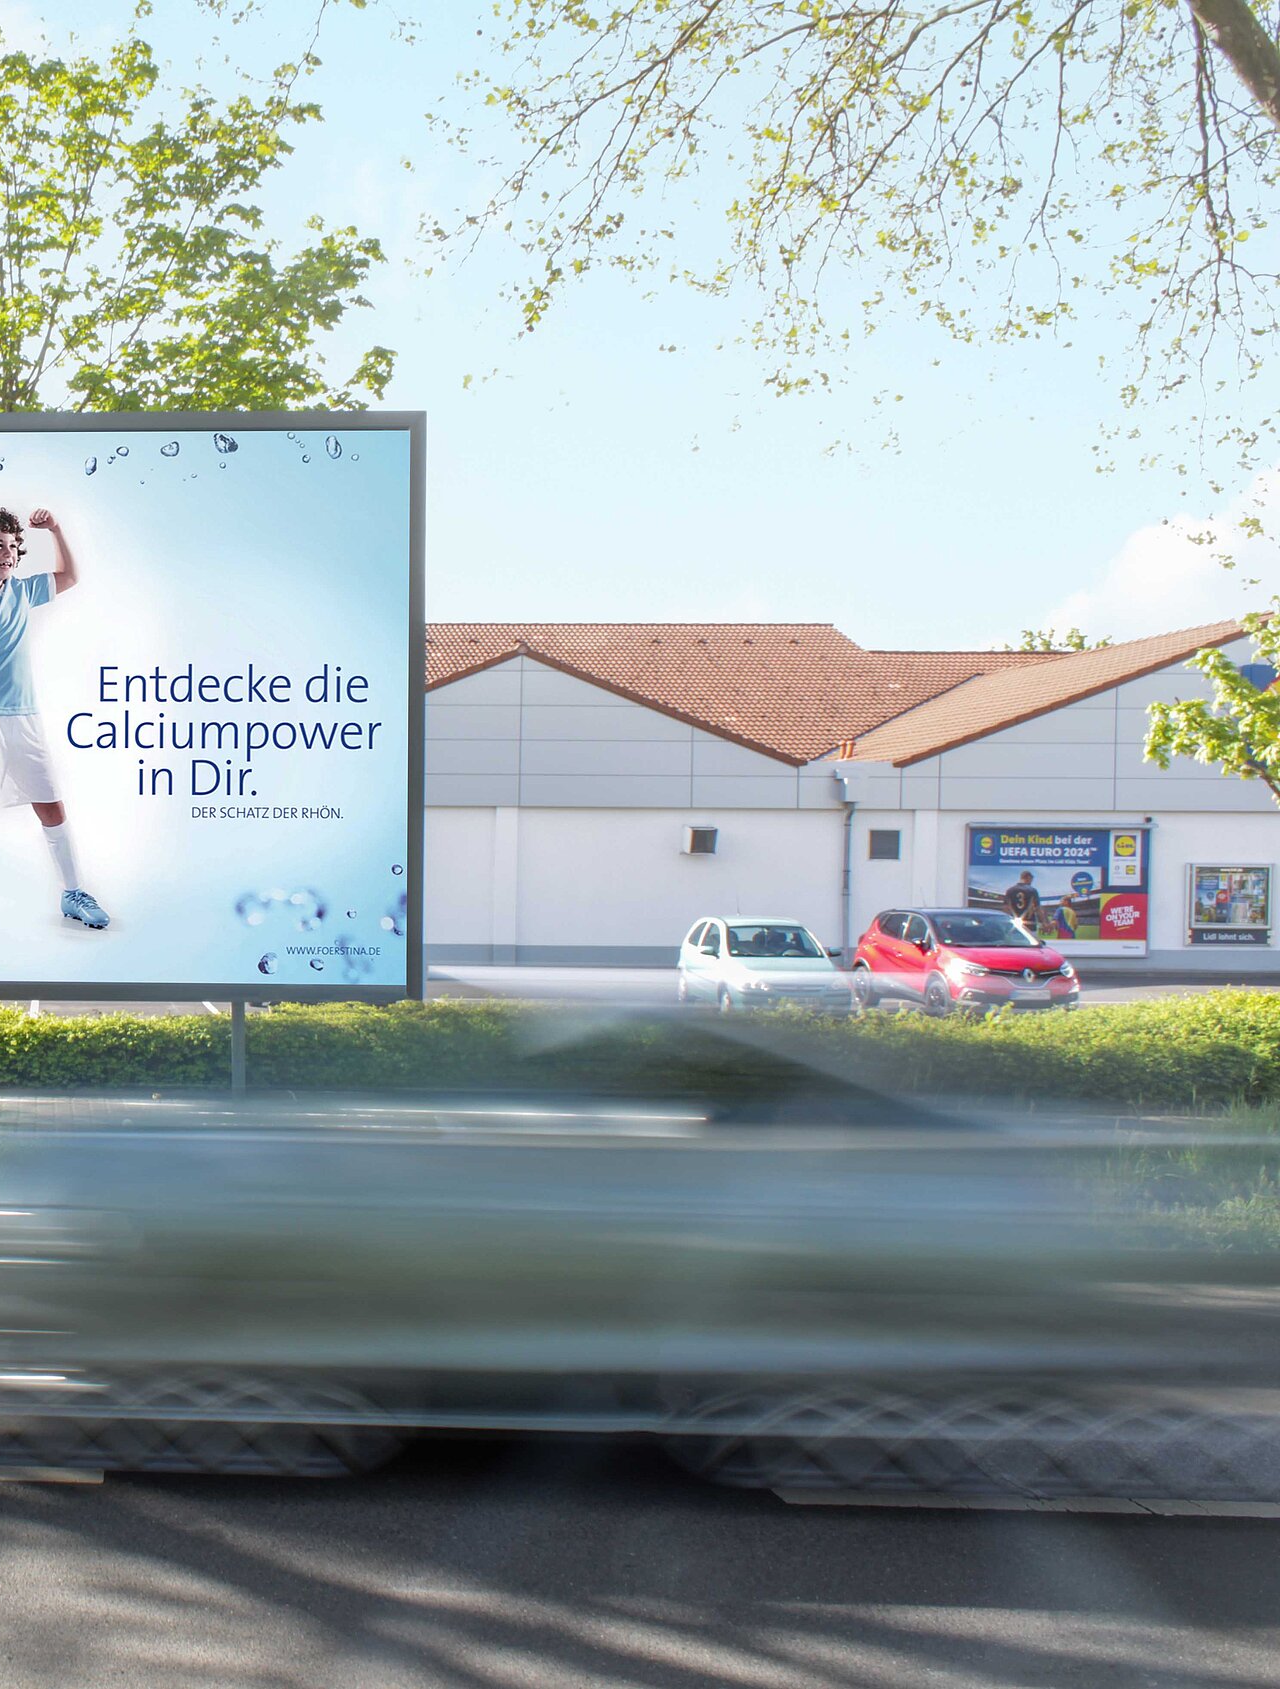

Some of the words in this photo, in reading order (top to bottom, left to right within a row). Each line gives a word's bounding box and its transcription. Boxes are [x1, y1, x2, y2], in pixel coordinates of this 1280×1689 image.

[99, 663, 291, 702] Entdecke
[305, 663, 369, 703] die
[66, 710, 382, 762] Calciumpower
[138, 759, 173, 796] in
[191, 759, 257, 796] Dir.
[191, 806, 217, 819] DER
[219, 806, 270, 819] SCHATZ
[273, 806, 298, 819] DER
[301, 805, 344, 819] RHÖN.
[1000, 834, 1025, 844] Dein
[1028, 834, 1053, 844] Kind
[1055, 835, 1072, 845] bei
[1073, 835, 1092, 845] der
[999, 847, 1028, 857] UEFA
[1030, 847, 1061, 857] EURO
[1016, 891, 1025, 909] 3
[1203, 932, 1217, 940] Lidl
[285, 946, 381, 956] WWW.FOERSTINA.DE
